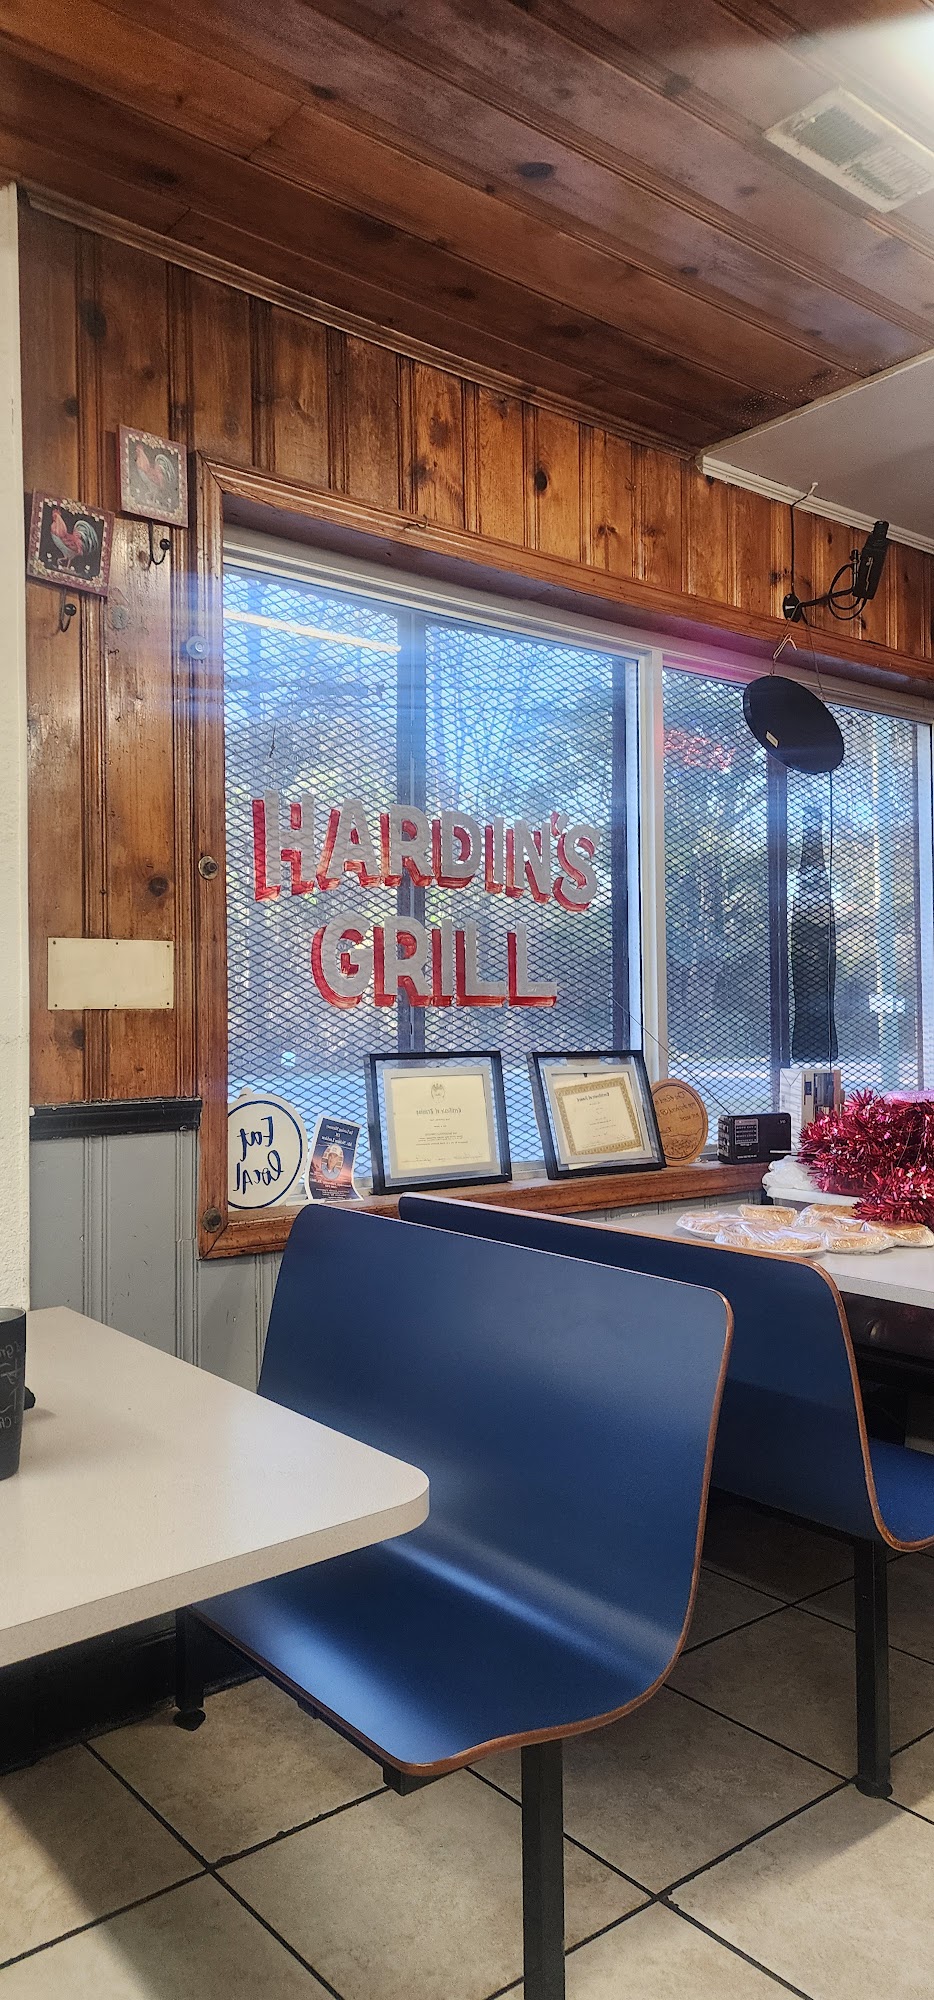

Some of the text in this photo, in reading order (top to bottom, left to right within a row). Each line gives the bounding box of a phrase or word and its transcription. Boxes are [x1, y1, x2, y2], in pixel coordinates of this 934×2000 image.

[664, 729, 736, 771] PEN
[252, 789, 601, 912] HARDIN'S
[311, 911, 557, 1008] GRILL
